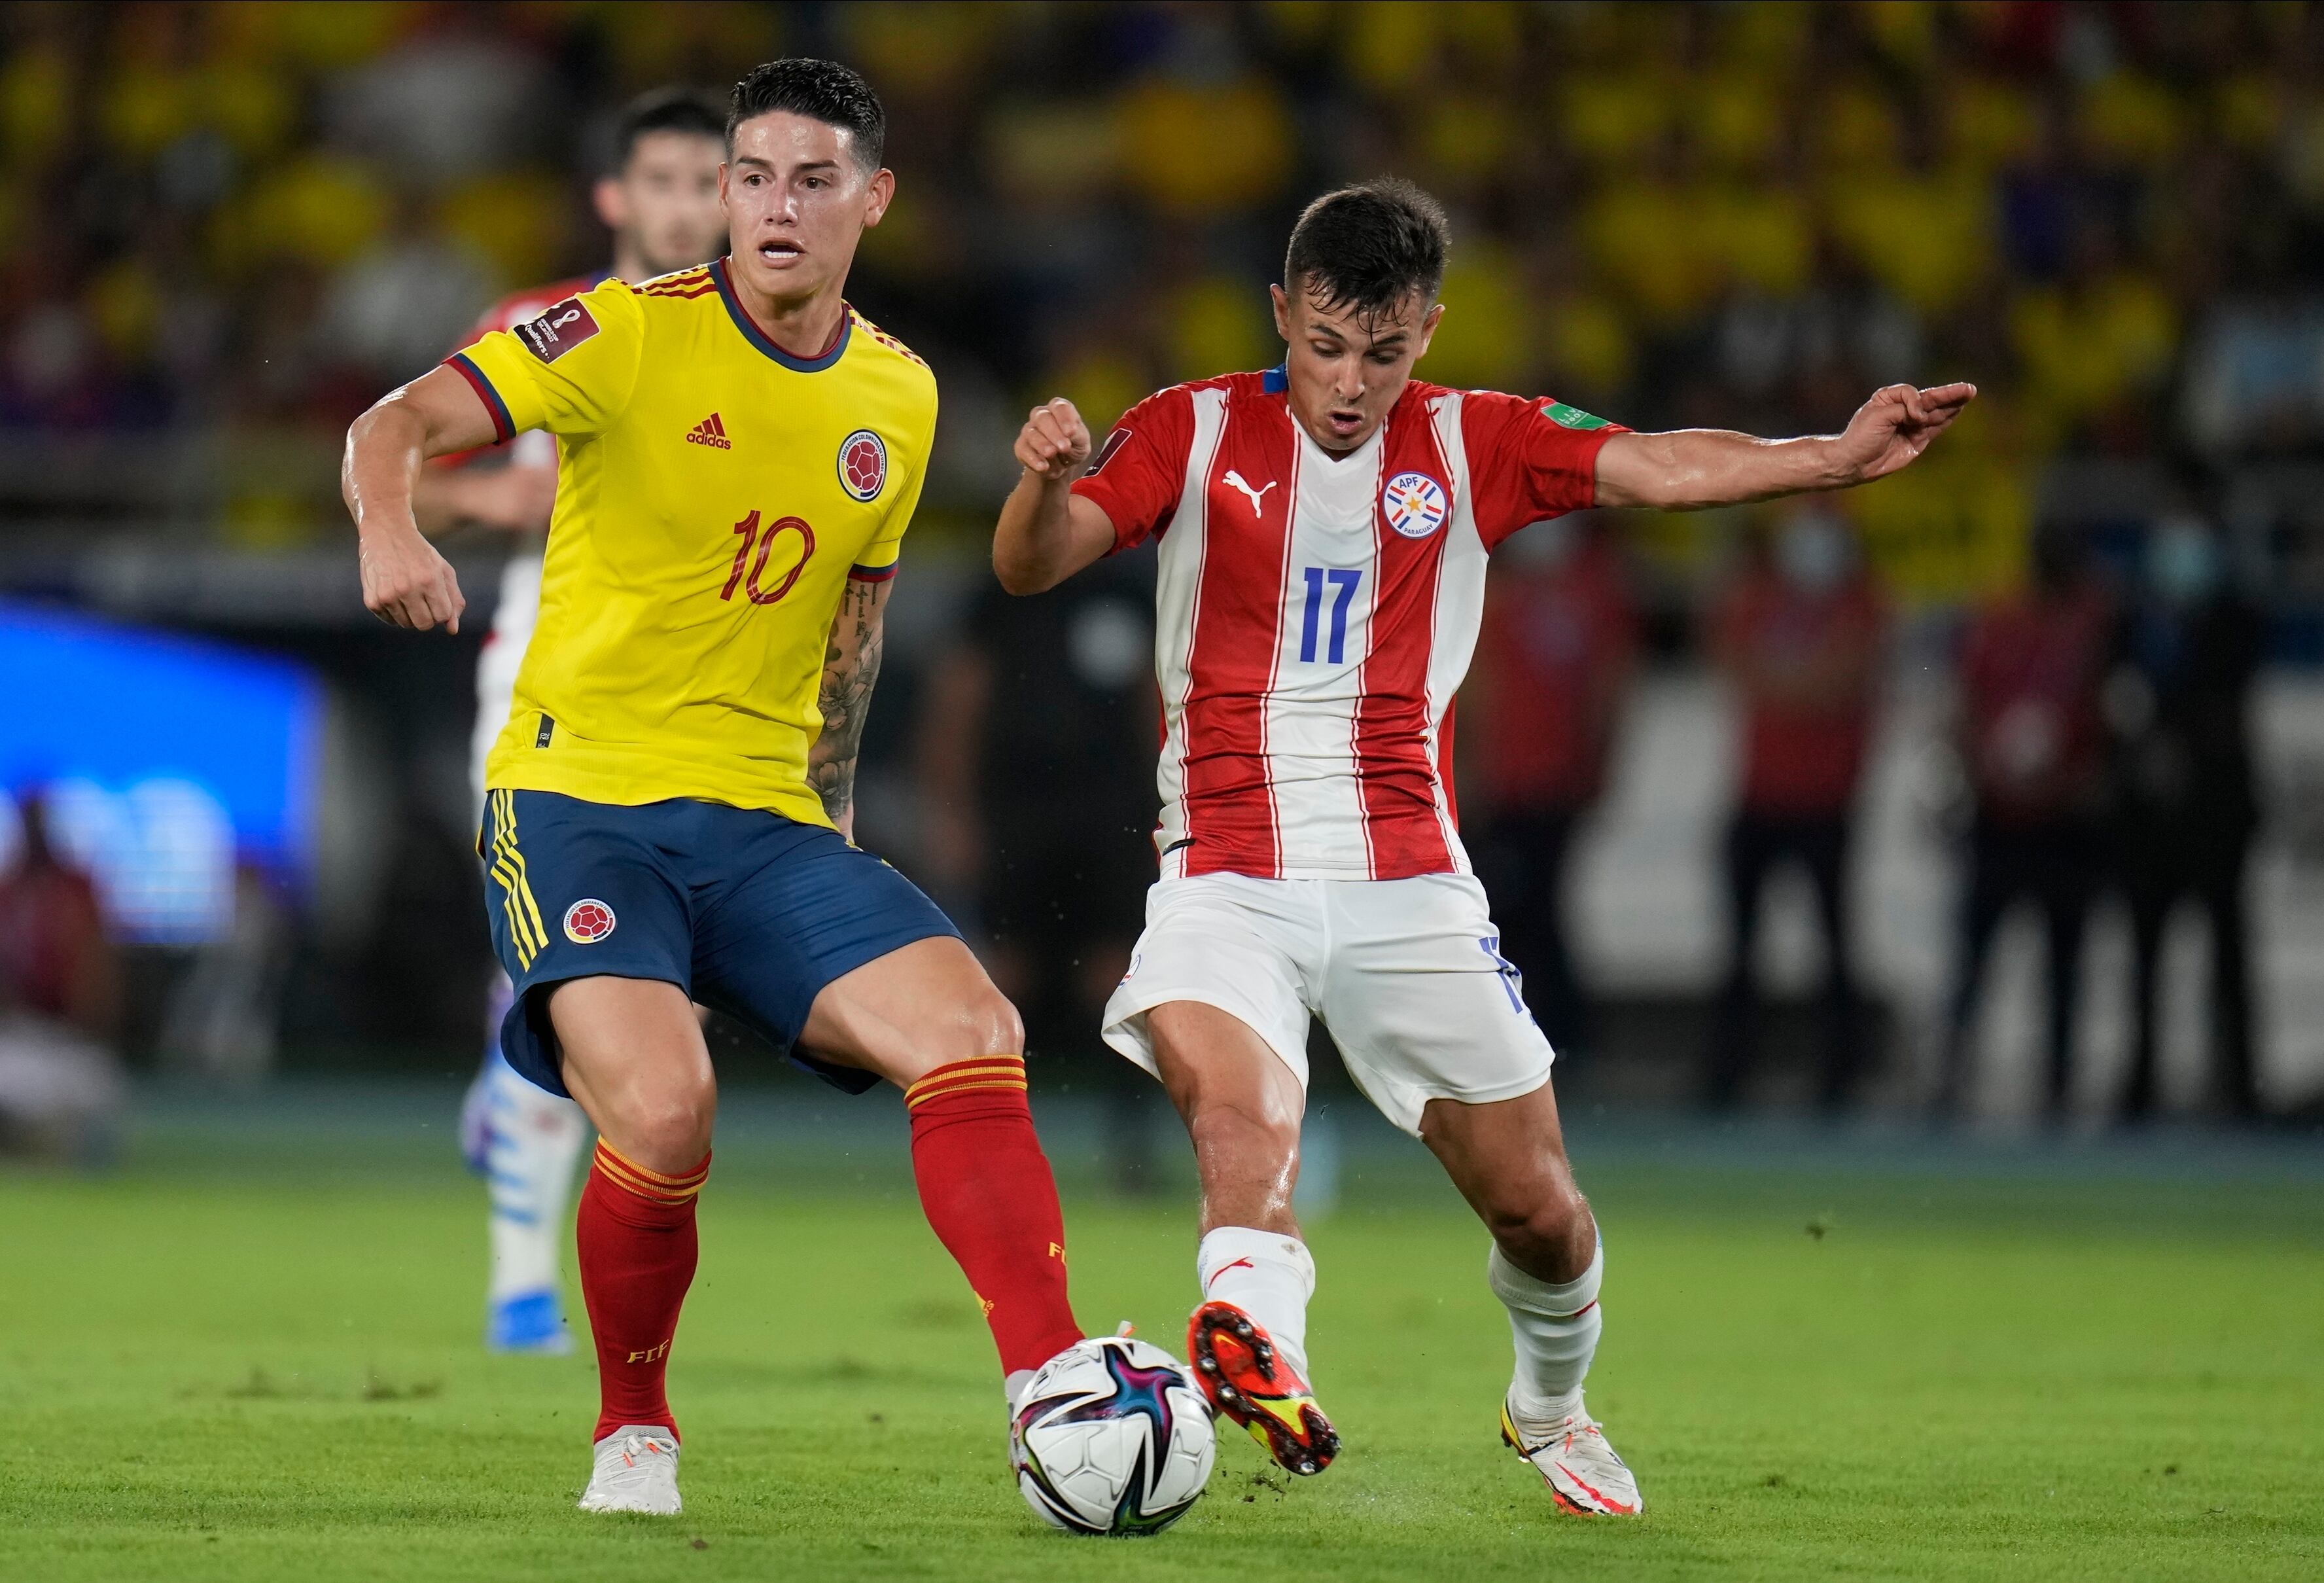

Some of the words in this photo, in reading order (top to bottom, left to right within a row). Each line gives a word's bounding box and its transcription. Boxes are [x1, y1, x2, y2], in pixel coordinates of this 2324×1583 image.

[525, 324, 548, 354] Qualifiers
[686, 432, 731, 450] adidas
[1399, 476, 1419, 489] APF
[1403, 523, 1434, 535] PARAGUAY
[720, 509, 816, 605] 10
[1300, 567, 1363, 664] 17
[627, 1339, 669, 1364] FCF
